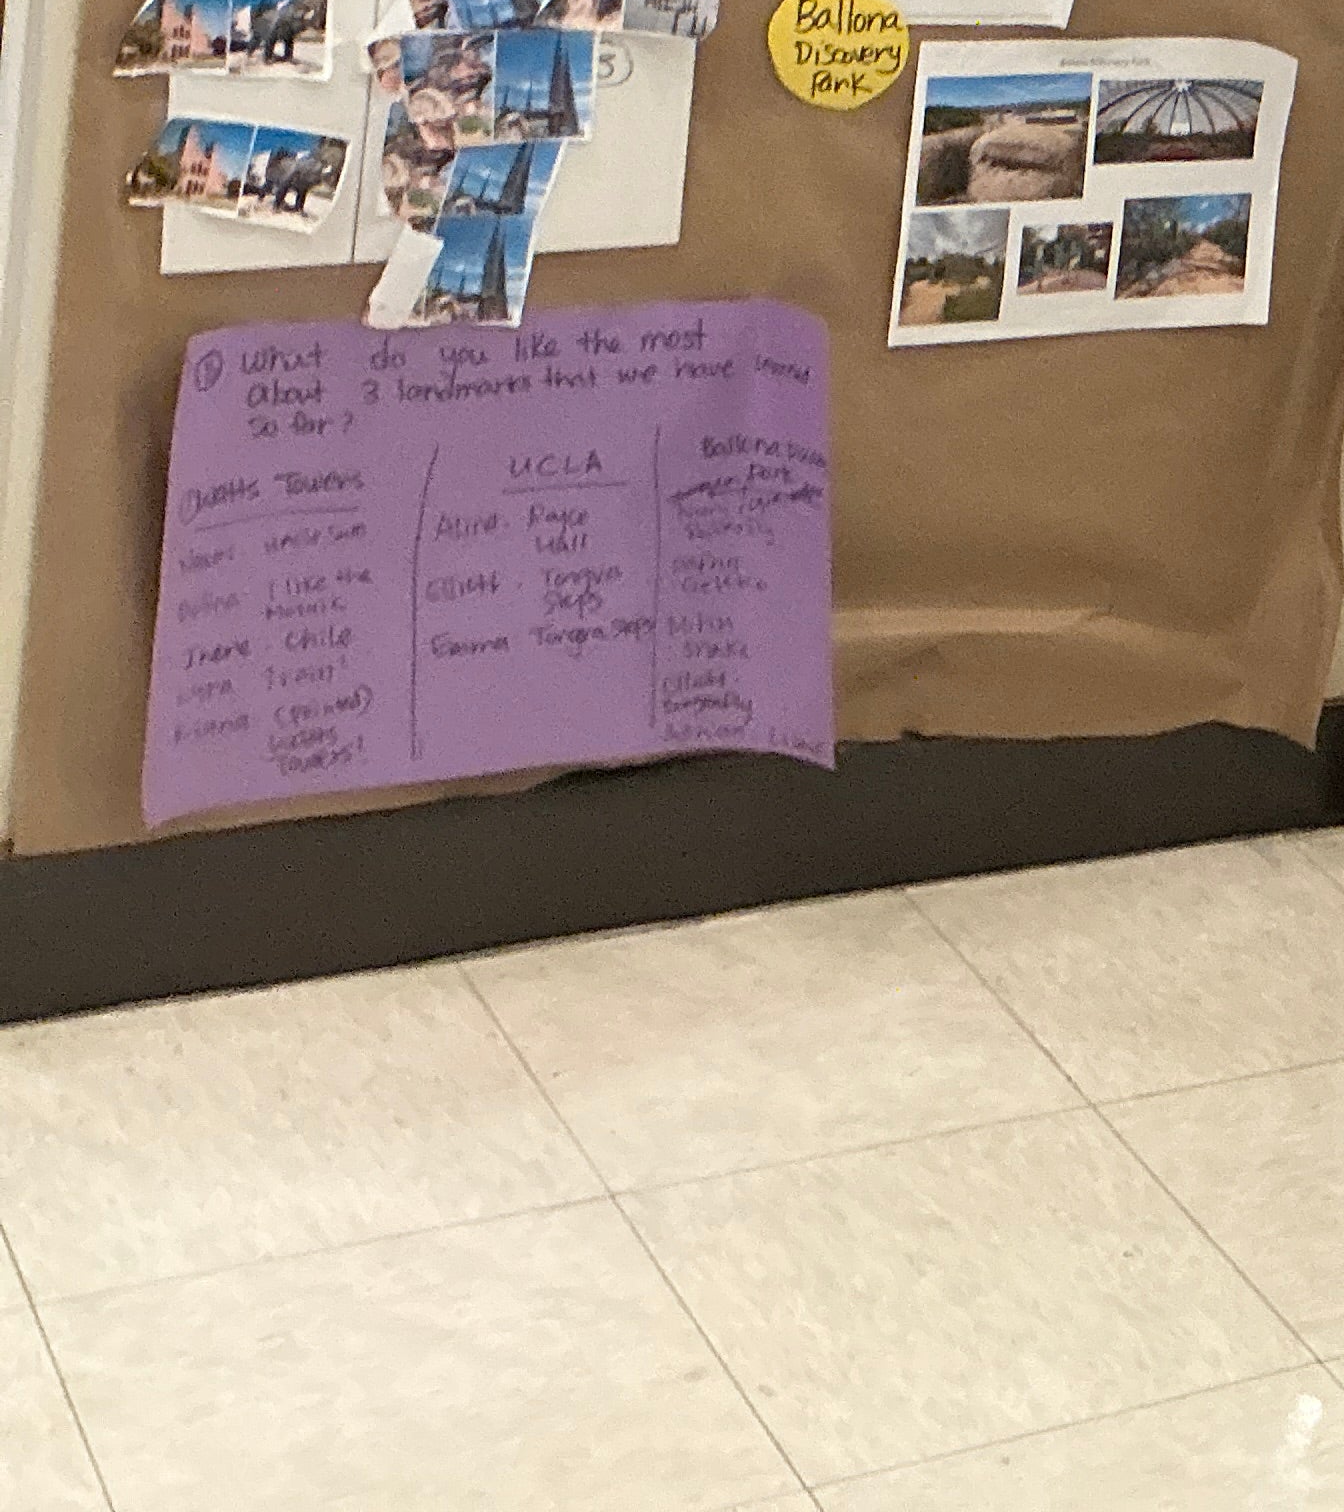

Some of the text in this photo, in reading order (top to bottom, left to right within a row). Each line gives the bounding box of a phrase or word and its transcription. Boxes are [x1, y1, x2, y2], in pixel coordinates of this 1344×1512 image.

[794, 40, 902, 76] Discovery
[810, 69, 873, 99] Park
[513, 330, 562, 363] like
[574, 327, 622, 356] the
[639, 317, 708, 354] most
[508, 447, 604, 480] UCLA
